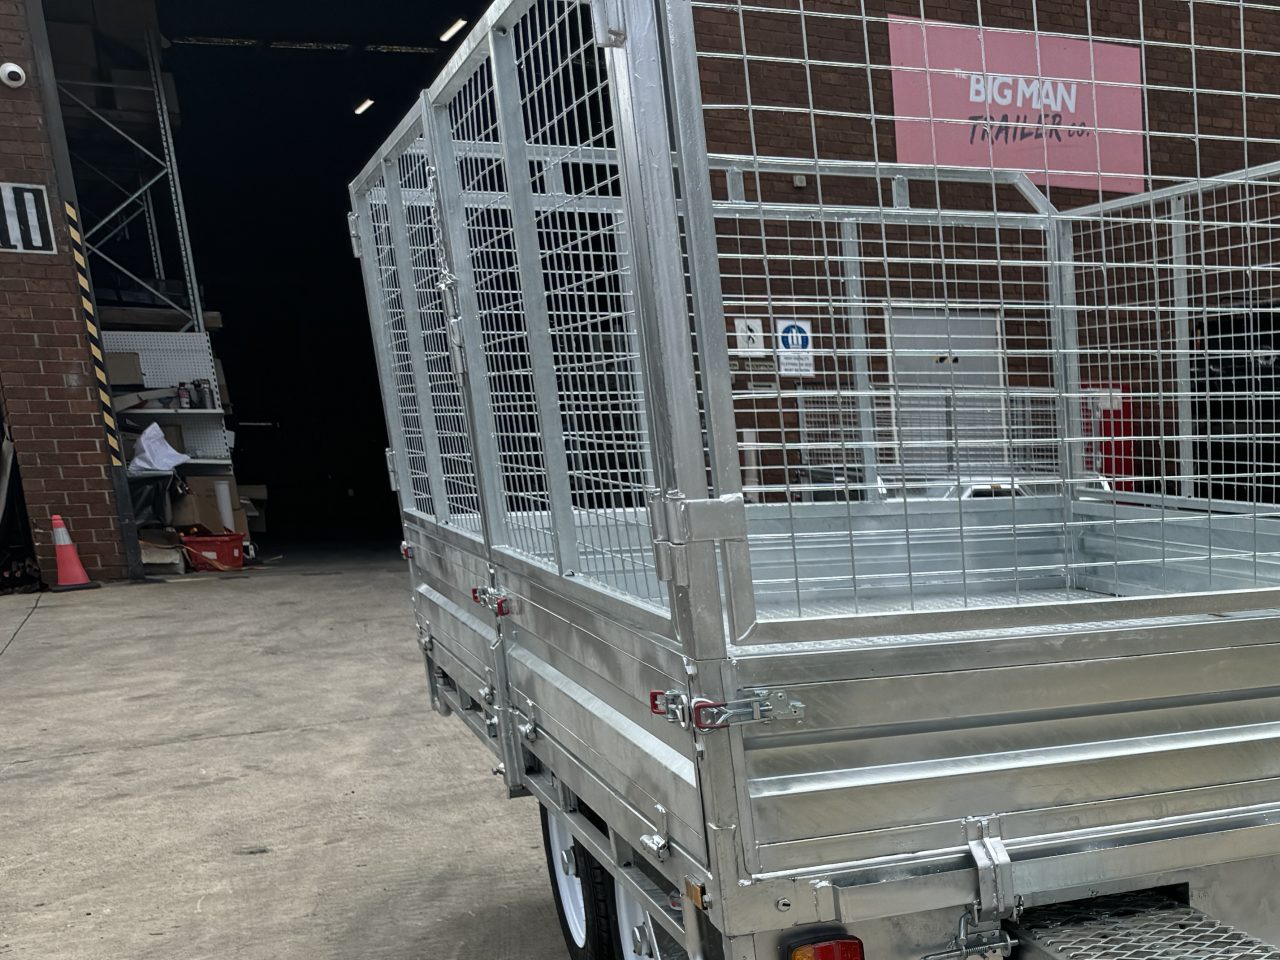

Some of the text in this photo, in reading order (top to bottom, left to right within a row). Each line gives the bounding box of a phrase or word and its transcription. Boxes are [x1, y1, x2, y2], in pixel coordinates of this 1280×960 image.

[969, 74, 1077, 114] BIG MAN
[967, 113, 1062, 145] TRAILER
